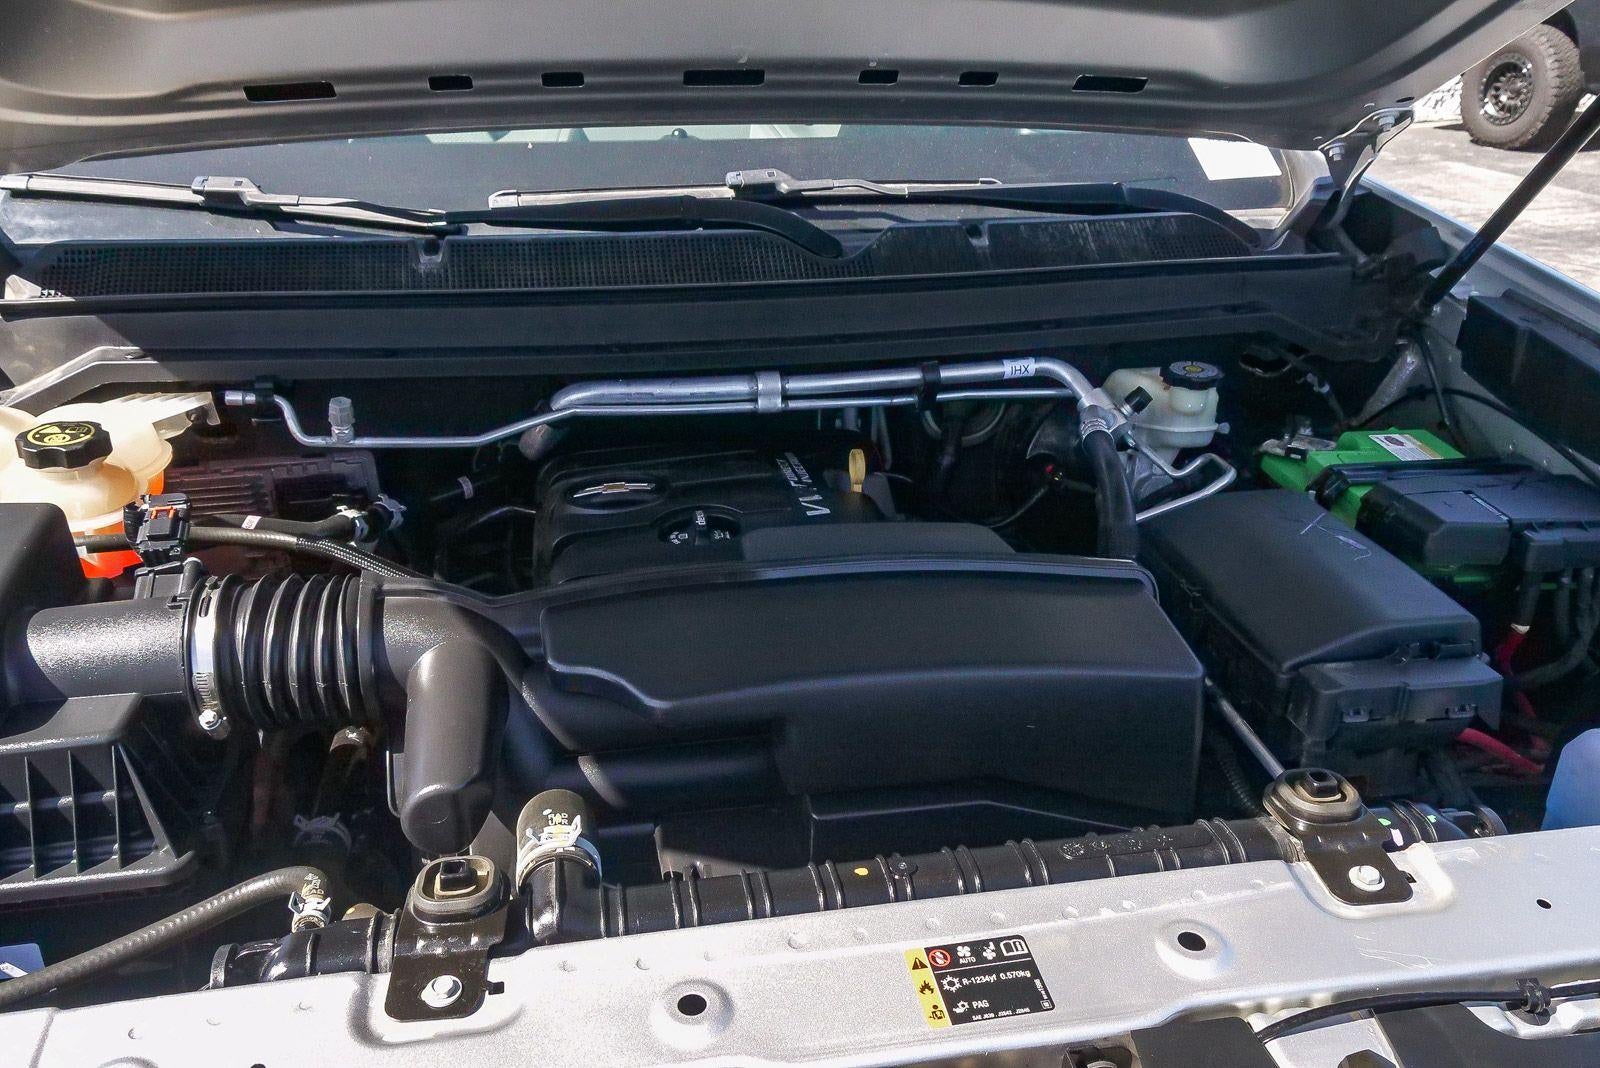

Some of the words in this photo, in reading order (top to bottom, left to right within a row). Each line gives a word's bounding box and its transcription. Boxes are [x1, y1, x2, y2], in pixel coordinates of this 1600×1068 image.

[962, 973, 997, 986] R-1234yf
[1000, 970, 1031, 981] 0.570kg
[972, 1000, 989, 1009] PAG
